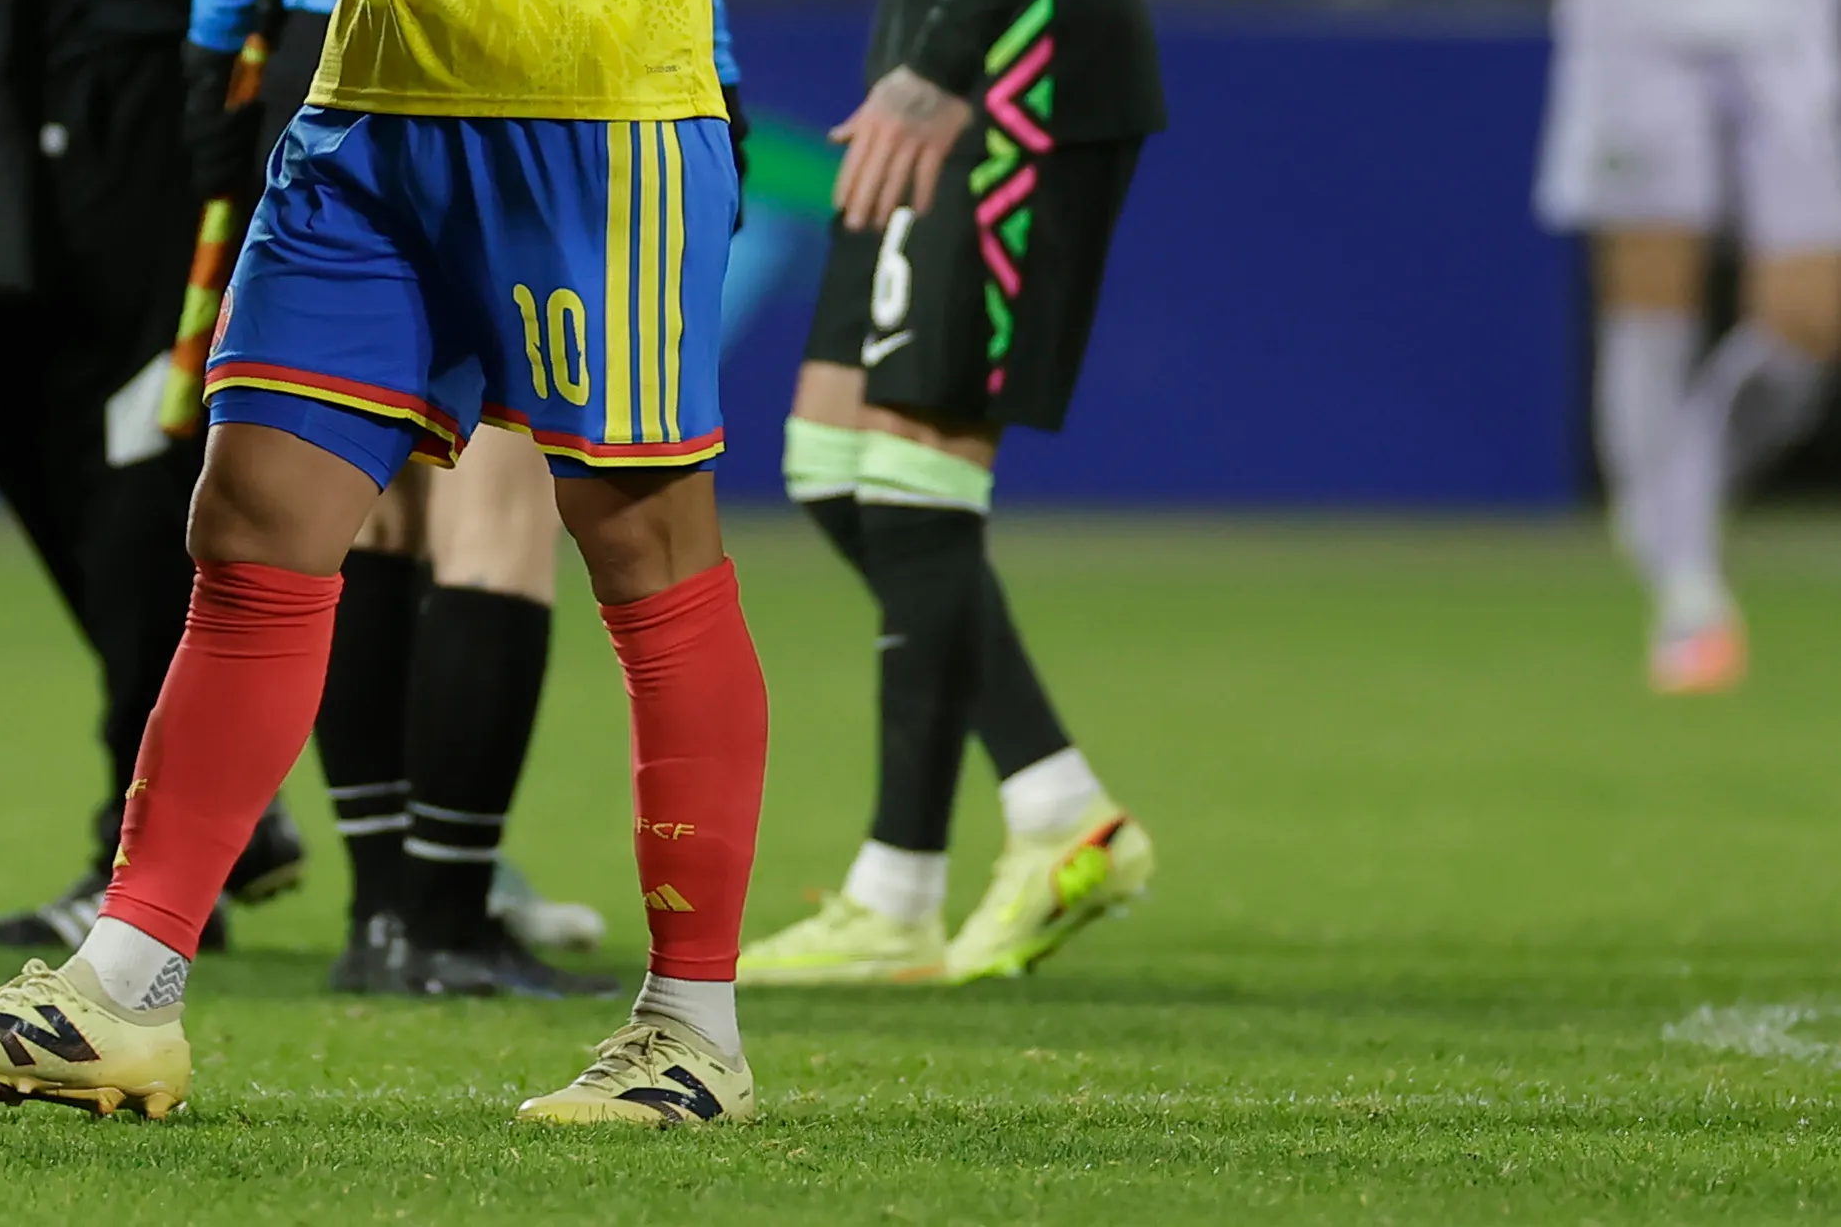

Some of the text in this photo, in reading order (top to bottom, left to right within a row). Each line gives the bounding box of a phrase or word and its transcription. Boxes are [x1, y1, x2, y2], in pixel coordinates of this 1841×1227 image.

[870, 205, 916, 329] 6
[511, 283, 590, 407] 10
[635, 816, 696, 840] FCF
